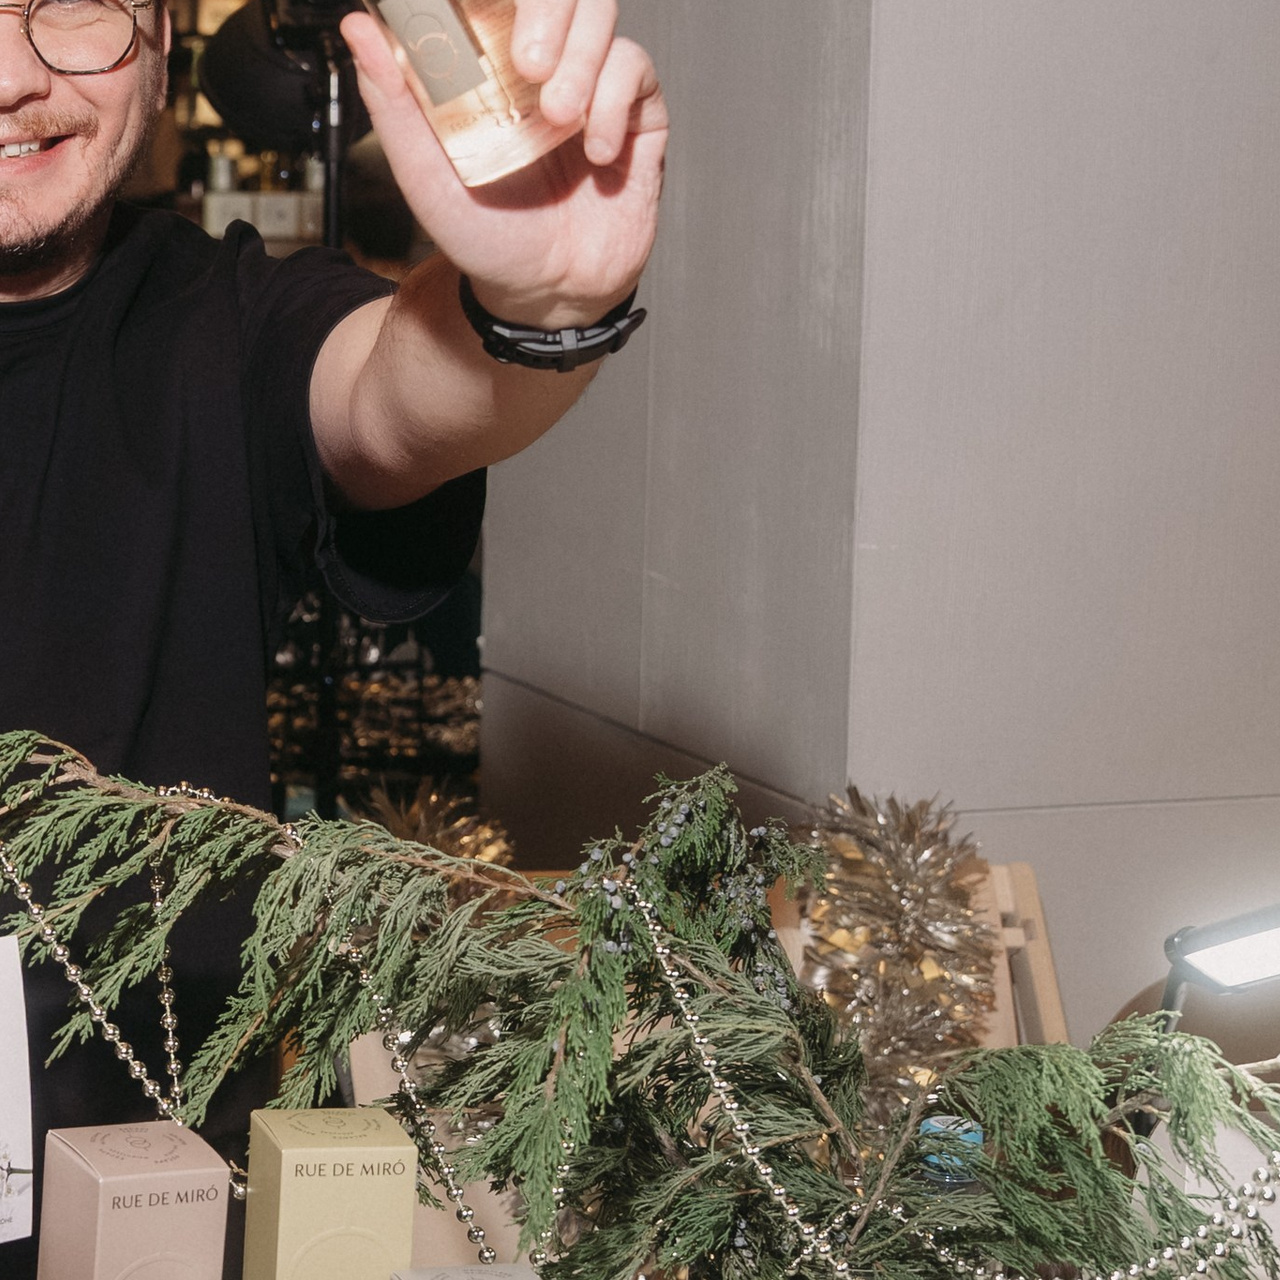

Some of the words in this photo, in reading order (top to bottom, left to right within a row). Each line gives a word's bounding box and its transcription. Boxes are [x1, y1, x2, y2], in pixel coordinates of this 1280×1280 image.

[295, 1163, 326, 1177] RUE
[333, 1162, 354, 1176] DE
[360, 1158, 405, 1176] MIRÓ
[112, 1193, 143, 1210] RUE
[148, 1191, 169, 1207] DE
[175, 1184, 218, 1204] MIRÓ
